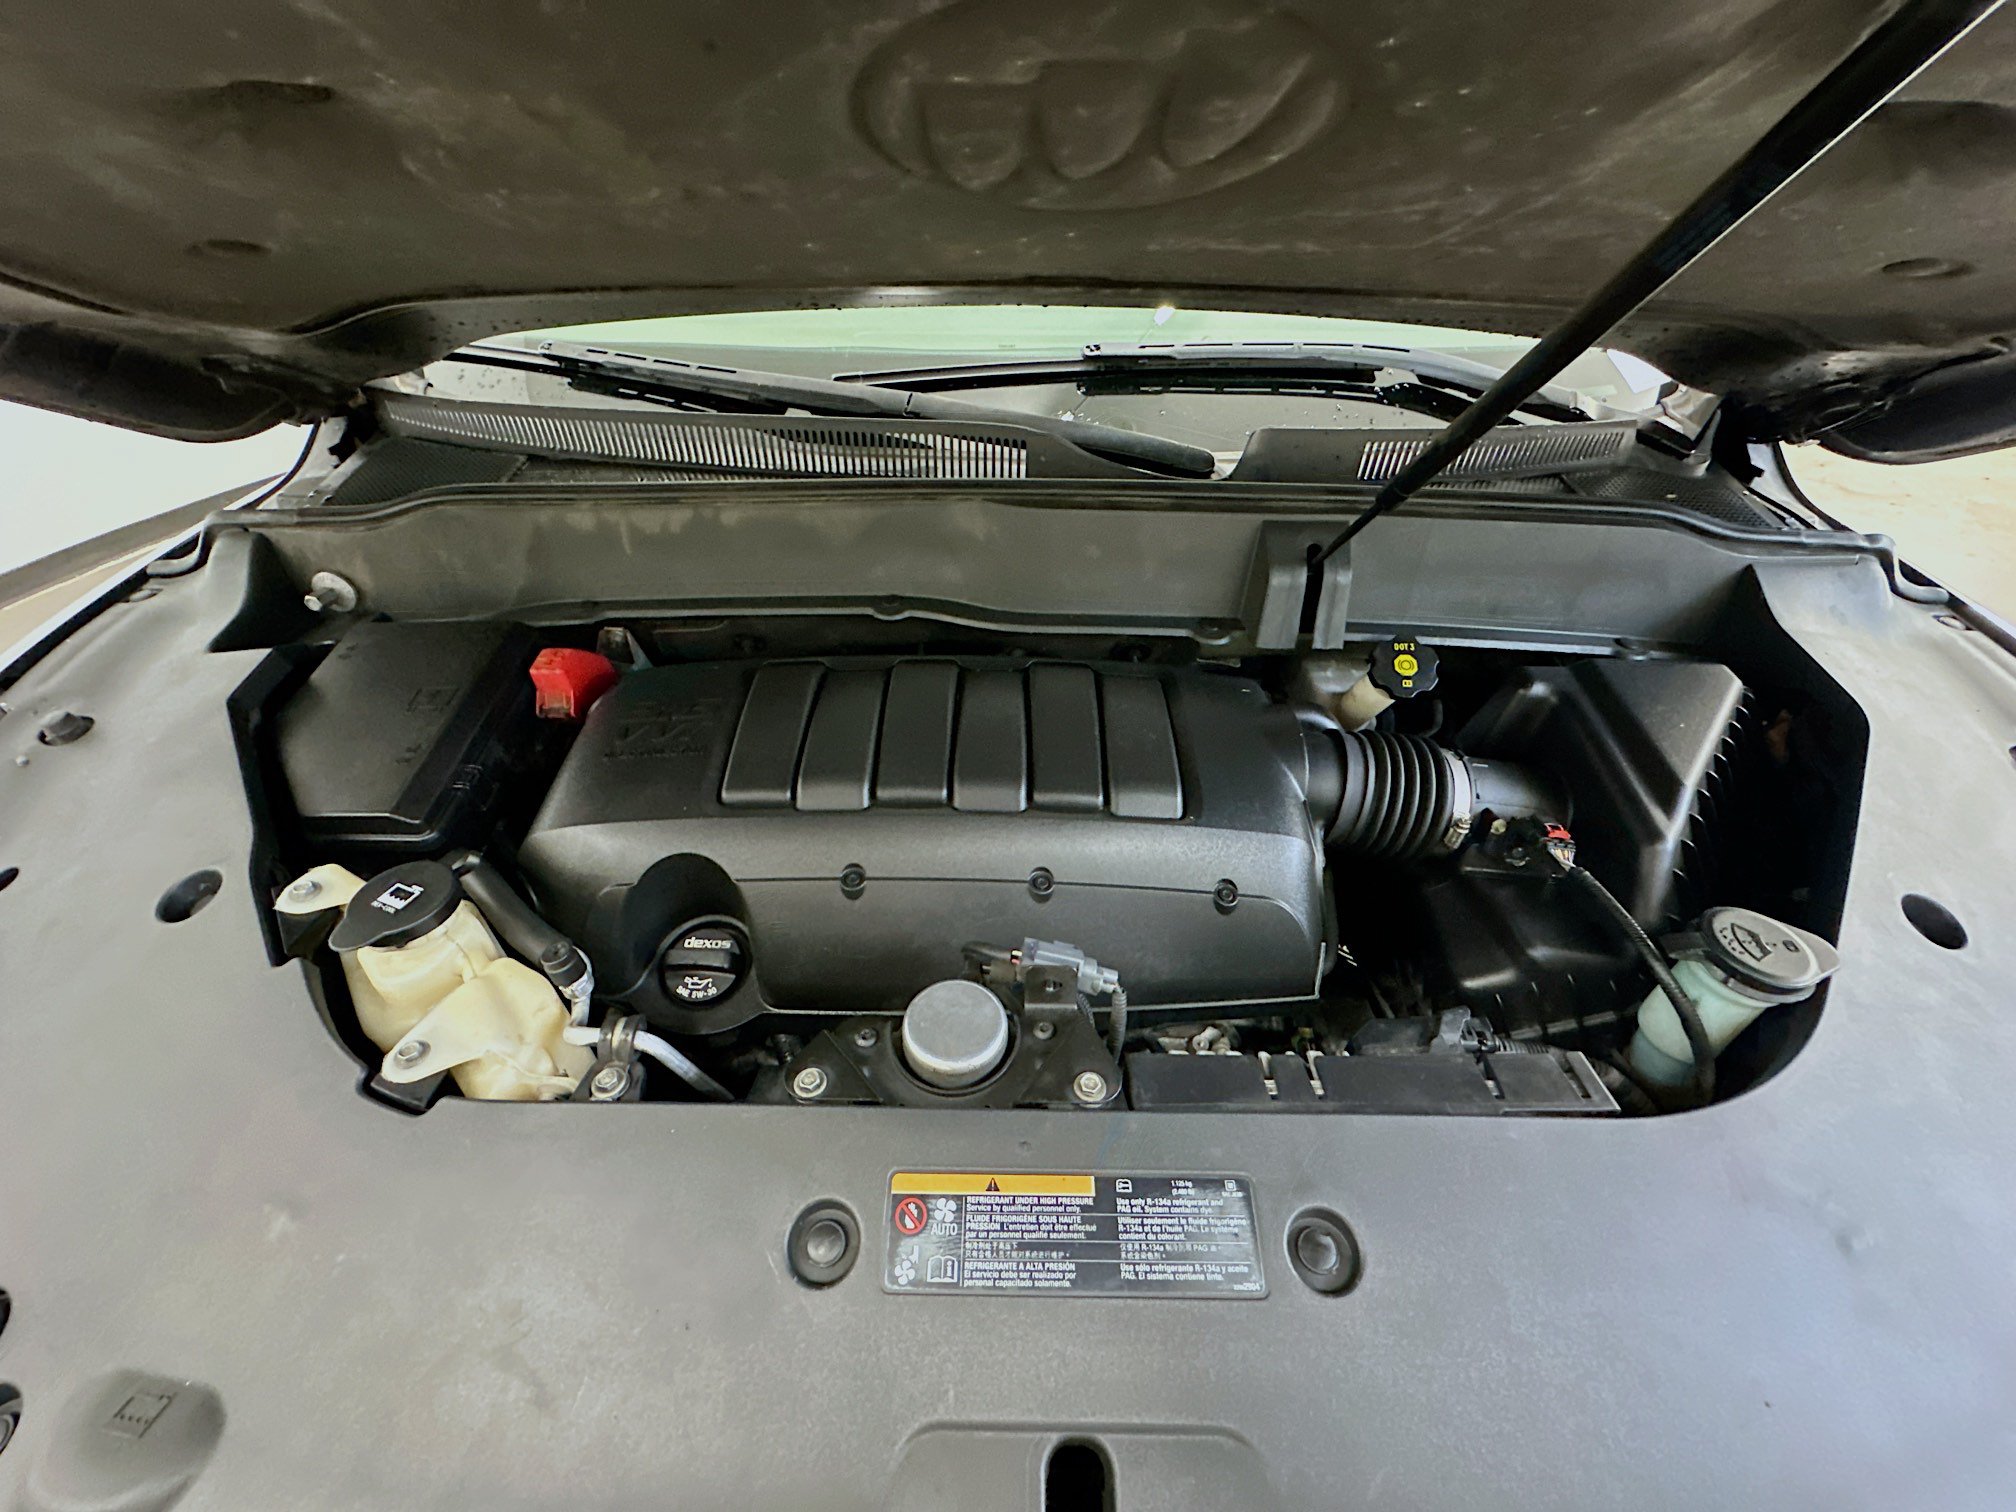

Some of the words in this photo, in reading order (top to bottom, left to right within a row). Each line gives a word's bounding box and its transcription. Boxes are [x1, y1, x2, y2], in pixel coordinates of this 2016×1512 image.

[1394, 643, 1408, 651] DOT
[1409, 643, 1415, 651] 3
[684, 937, 731, 949] dexos
[676, 986, 691, 997] SAE
[691, 986, 718, 999] 5W-30
[966, 1196, 1014, 1204] REFRIGERANT
[1015, 1196, 1038, 1205] UNDER
[1040, 1197, 1056, 1205] HIGH
[1058, 1197, 1094, 1205] PRESSURE
[1131, 1198, 1145, 1207] only
[1146, 1198, 1172, 1206] R-134a
[1172, 1198, 1210, 1207] refrigerant
[966, 1204, 991, 1212] Service
[993, 1204, 1000, 1213] by
[1002, 1204, 1031, 1213] qualified
[1032, 1205, 1065, 1213] personnel
[1117, 1205, 1131, 1213] PAG
[1145, 1205, 1169, 1215] System
[1170, 1206, 1199, 1214] contains
[992, 1214, 1037, 1223] FRIGORIGÈNE
[1038, 1215, 1057, 1223] SOUS
[1117, 1217, 1142, 1225] Utiliser
[1143, 1217, 1178, 1225] seulement
[1180, 1217, 1186, 1225] le
[1188, 1217, 1208, 1225] fluide
[931, 1223, 957, 1237] AUTO
[1004, 1223, 1038, 1231] L'entretien
[1040, 1223, 1053, 1231] doit
[1054, 1223, 1068, 1231] être
[1069, 1224, 1097, 1232] effectué
[988, 1231, 1022, 1239] personnel
[1141, 1244, 1164, 1252] R-134a
[1193, 1244, 1208, 1252] PAG
[964, 1261, 1018, 1270] REFRIGERANTE
[1018, 1262, 1025, 1270] A
[1026, 1262, 1043, 1270] ALTA
[1045, 1261, 1076, 1271] PRESIÓN
[1135, 1263, 1150, 1272] sólo
[1152, 1264, 1193, 1273] refrigerante
[1195, 1264, 1220, 1272] R-134a
[1221, 1266, 1226, 1274] y
[1227, 1265, 1249, 1273] aceite
[964, 1270, 971, 1278] El
[972, 1270, 999, 1279] servicio
[1000, 1270, 1018, 1279] debe
[1032, 1271, 1063, 1279] realizado
[1064, 1272, 1077, 1280] por
[1175, 1273, 1205, 1281] contiene
[964, 1279, 994, 1288] personal
[995, 1279, 1033, 1288] capacitado
